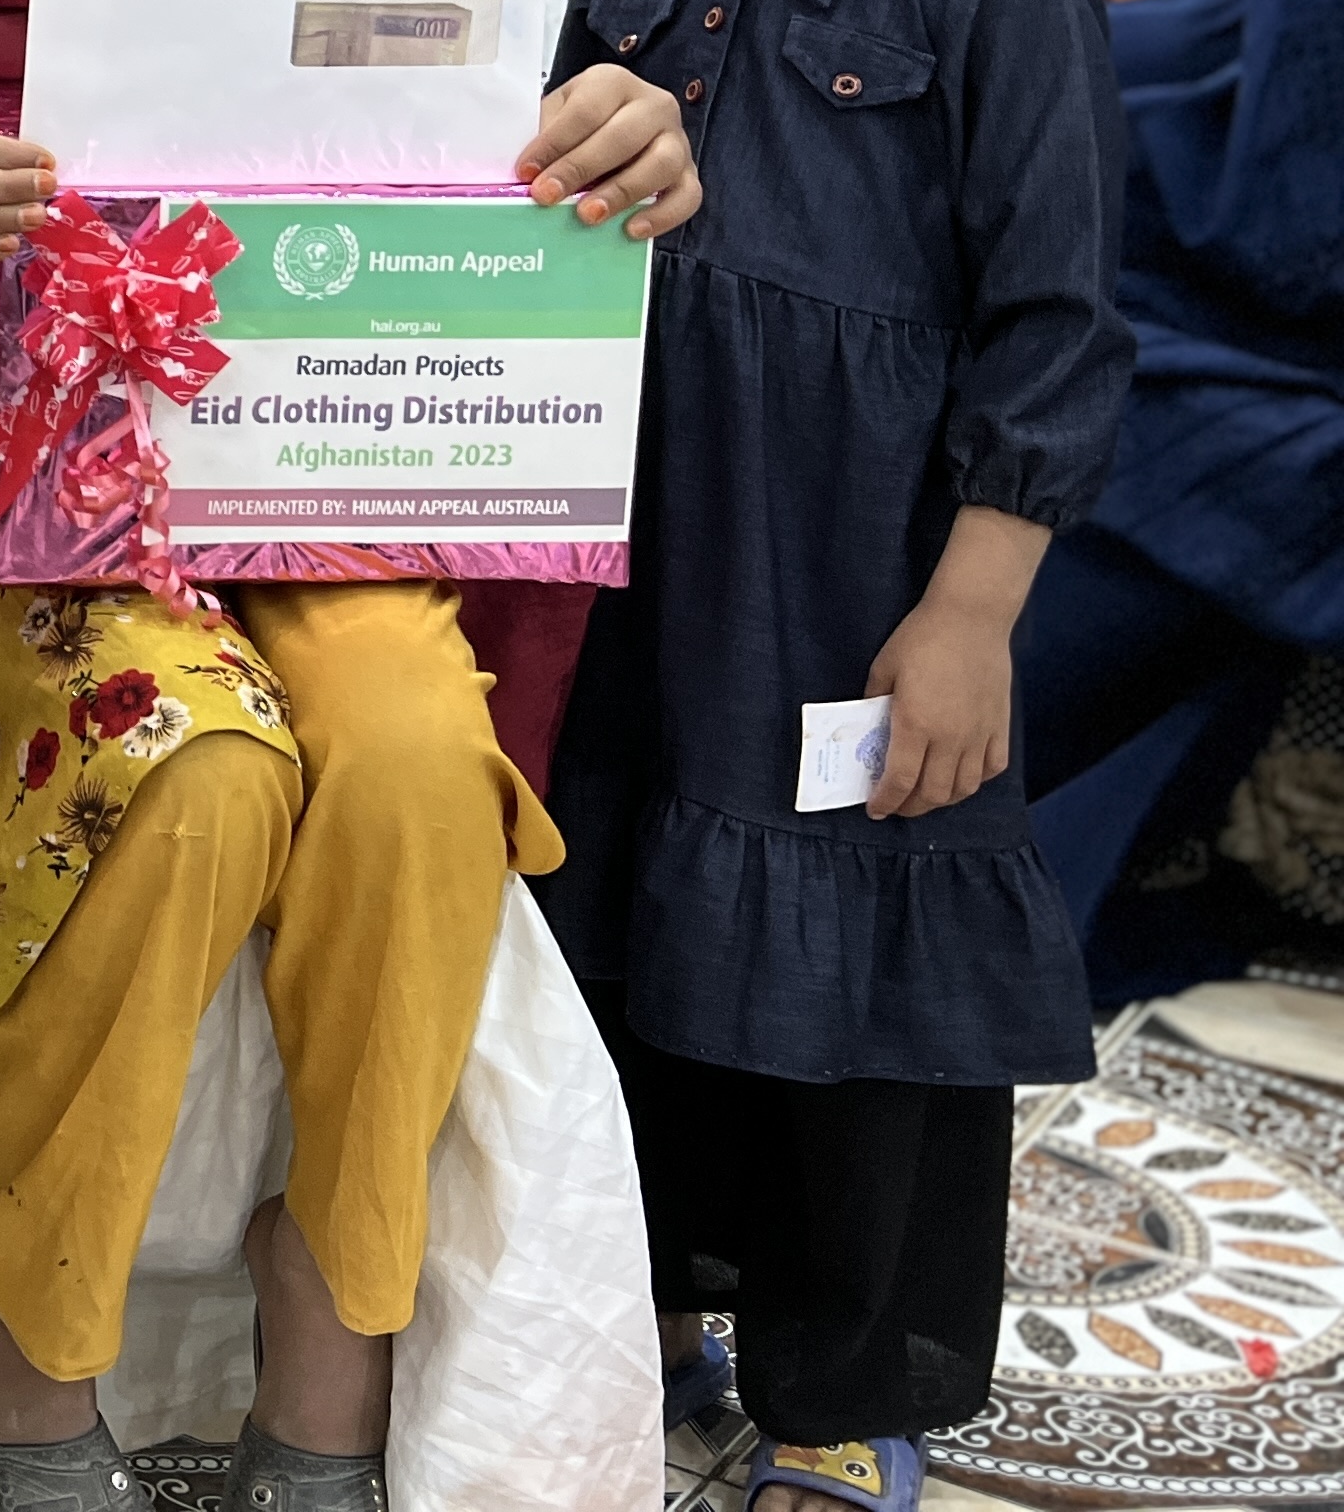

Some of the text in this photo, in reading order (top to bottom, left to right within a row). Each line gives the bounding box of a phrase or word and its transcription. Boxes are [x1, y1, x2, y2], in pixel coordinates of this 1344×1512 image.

[368, 248, 544, 279] Human Appeal
[370, 318, 442, 336] hai.org.au
[295, 353, 505, 382] Ramadan Projects
[190, 395, 604, 431] Eid Clothing Distribution
[275, 442, 513, 472] Afghanistan 2023
[207, 499, 570, 516] IMPLEMENTED BY: HUMAN APPEAL AUSTRALIA
